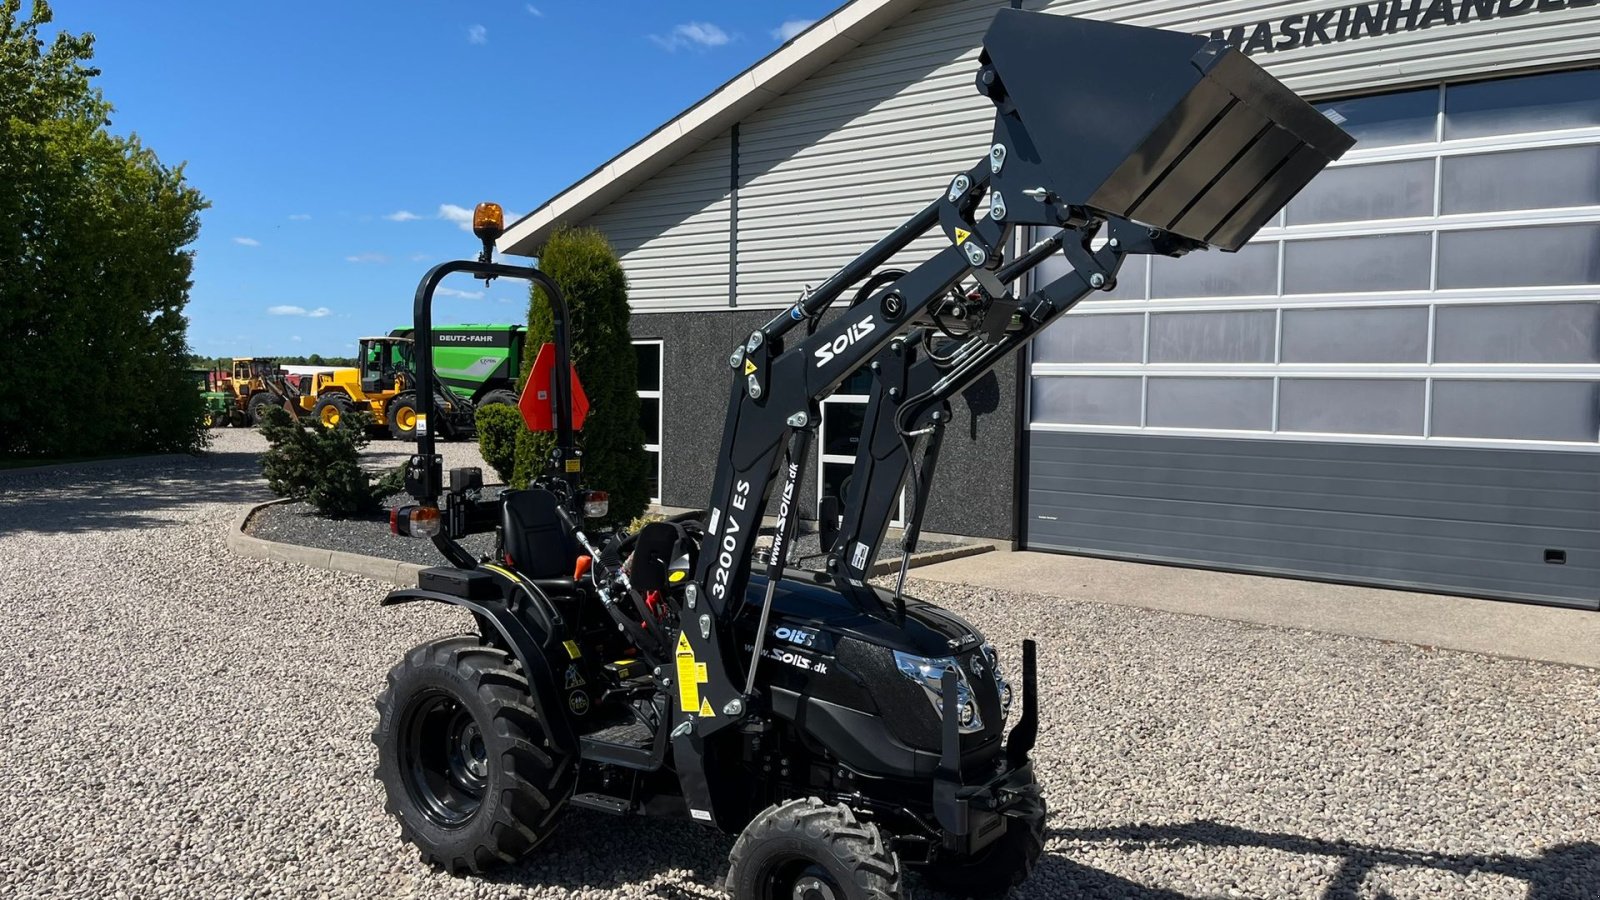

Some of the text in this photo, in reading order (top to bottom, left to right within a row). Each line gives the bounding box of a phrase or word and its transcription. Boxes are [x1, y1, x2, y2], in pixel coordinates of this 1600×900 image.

[1208, 0, 1600, 55] MASKINHAN
[712, 515, 740, 600] 3200V
[732, 479, 750, 511] ES
[744, 643, 828, 675] ww.Solis.dk
